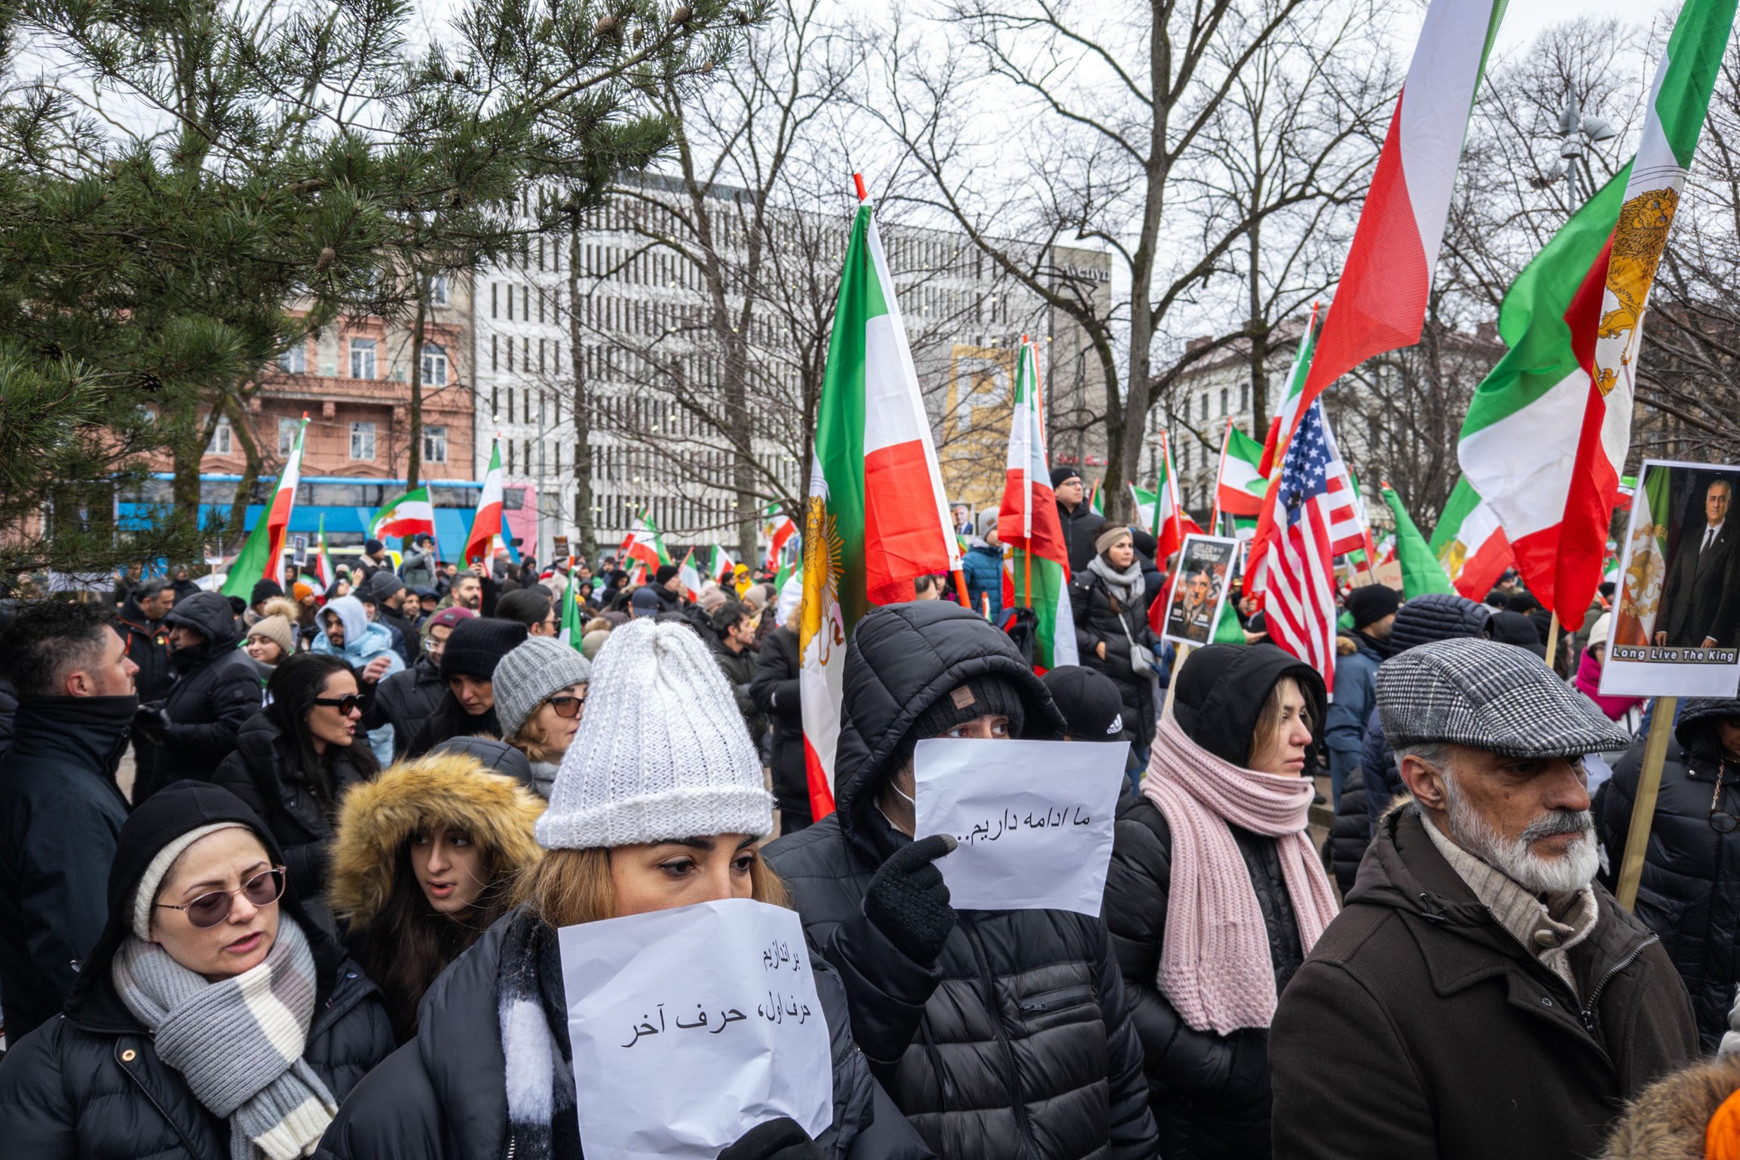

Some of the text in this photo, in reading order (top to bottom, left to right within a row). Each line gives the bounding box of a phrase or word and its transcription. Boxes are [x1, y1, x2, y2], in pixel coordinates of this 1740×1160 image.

[957, 355, 1009, 431] P
[1613, 647, 1735, 663] Long Live The King
[1023, 806, 1070, 830] ادامه
[1072, 806, 1091, 827] ما
[675, 1002, 747, 1034] حرف
[785, 995, 812, 1025] حرف
[621, 1002, 665, 1049] آخر
